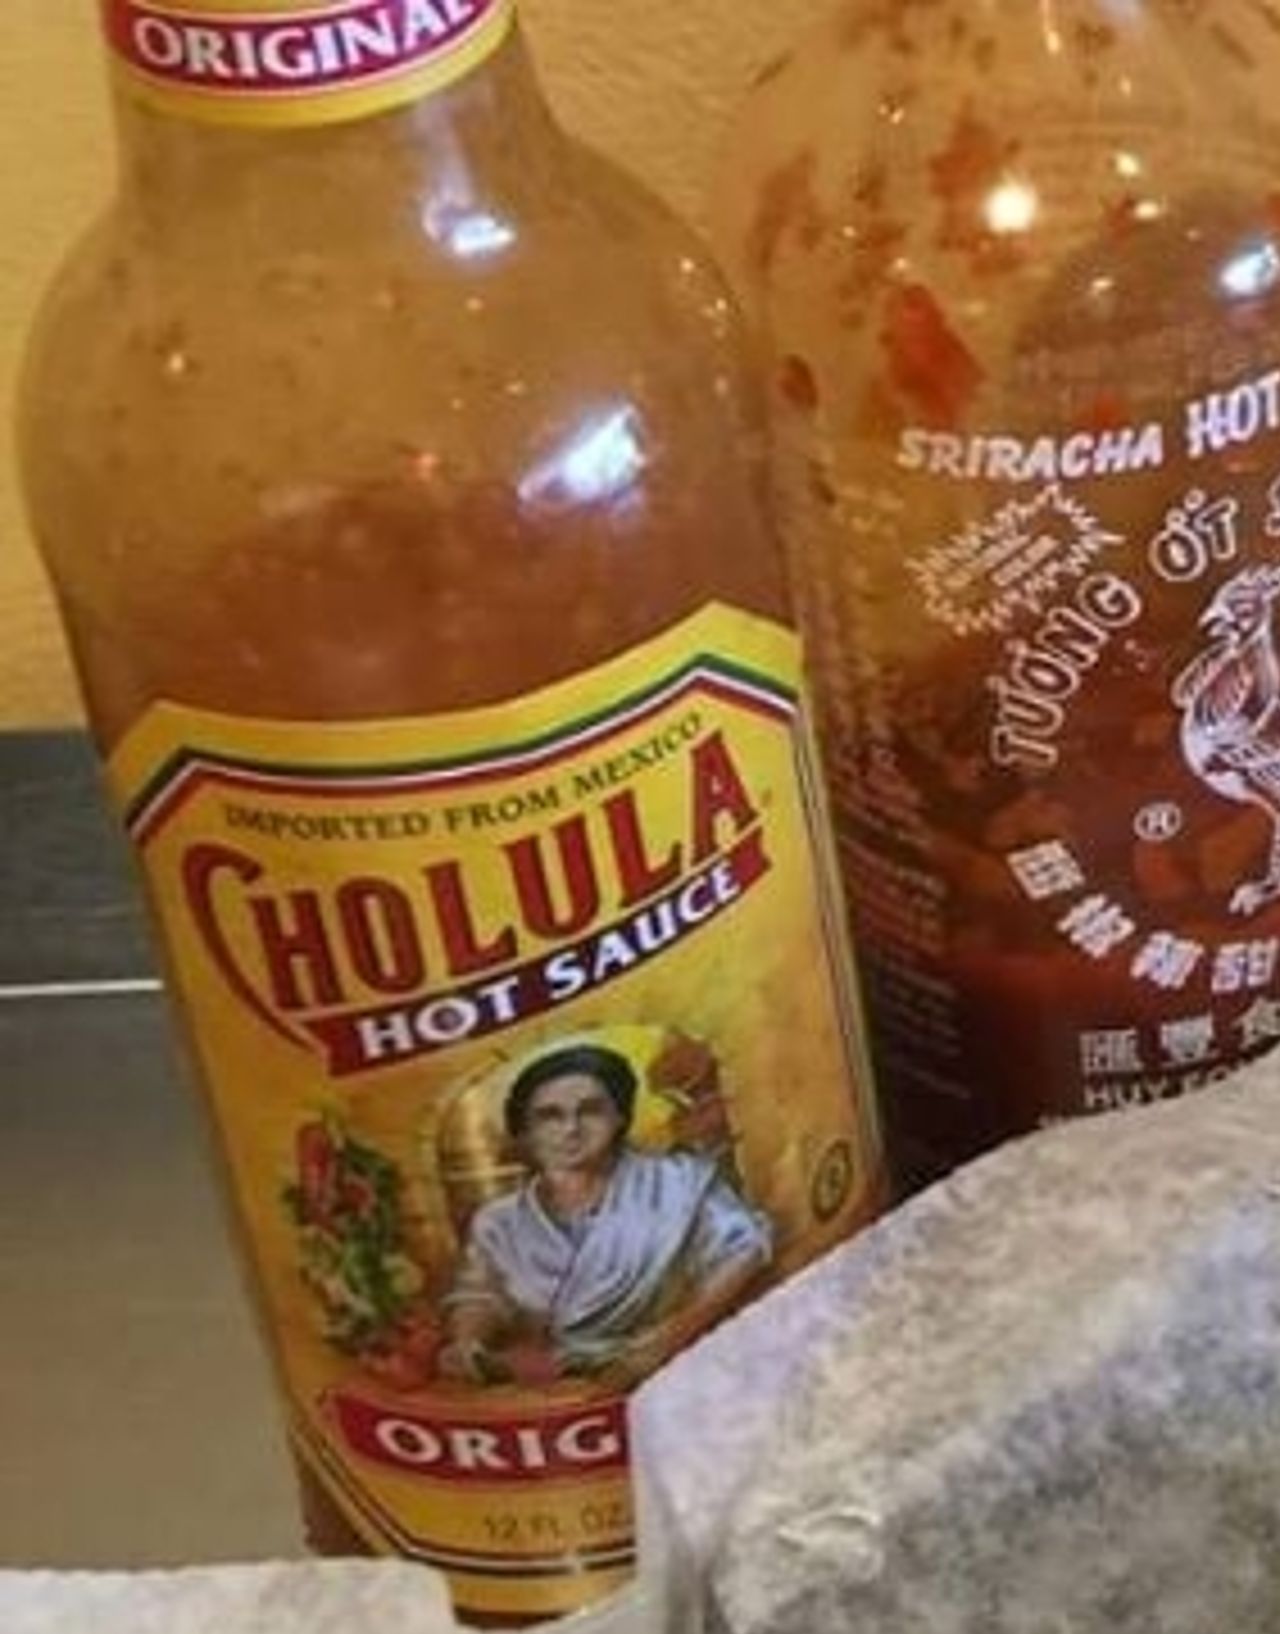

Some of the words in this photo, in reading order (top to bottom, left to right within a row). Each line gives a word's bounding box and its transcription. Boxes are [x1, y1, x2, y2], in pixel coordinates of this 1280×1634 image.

[897, 423, 1164, 479] SRIRACHA
[225, 803, 431, 842] IMPORTED
[445, 786, 560, 832] FROM
[572, 711, 703, 797] MEXICO
[181, 729, 760, 1056] CHOLULA
[354, 977, 520, 1058] HOT
[545, 860, 741, 1000] SAUCE
[375, 1416, 621, 1469] ORIG
